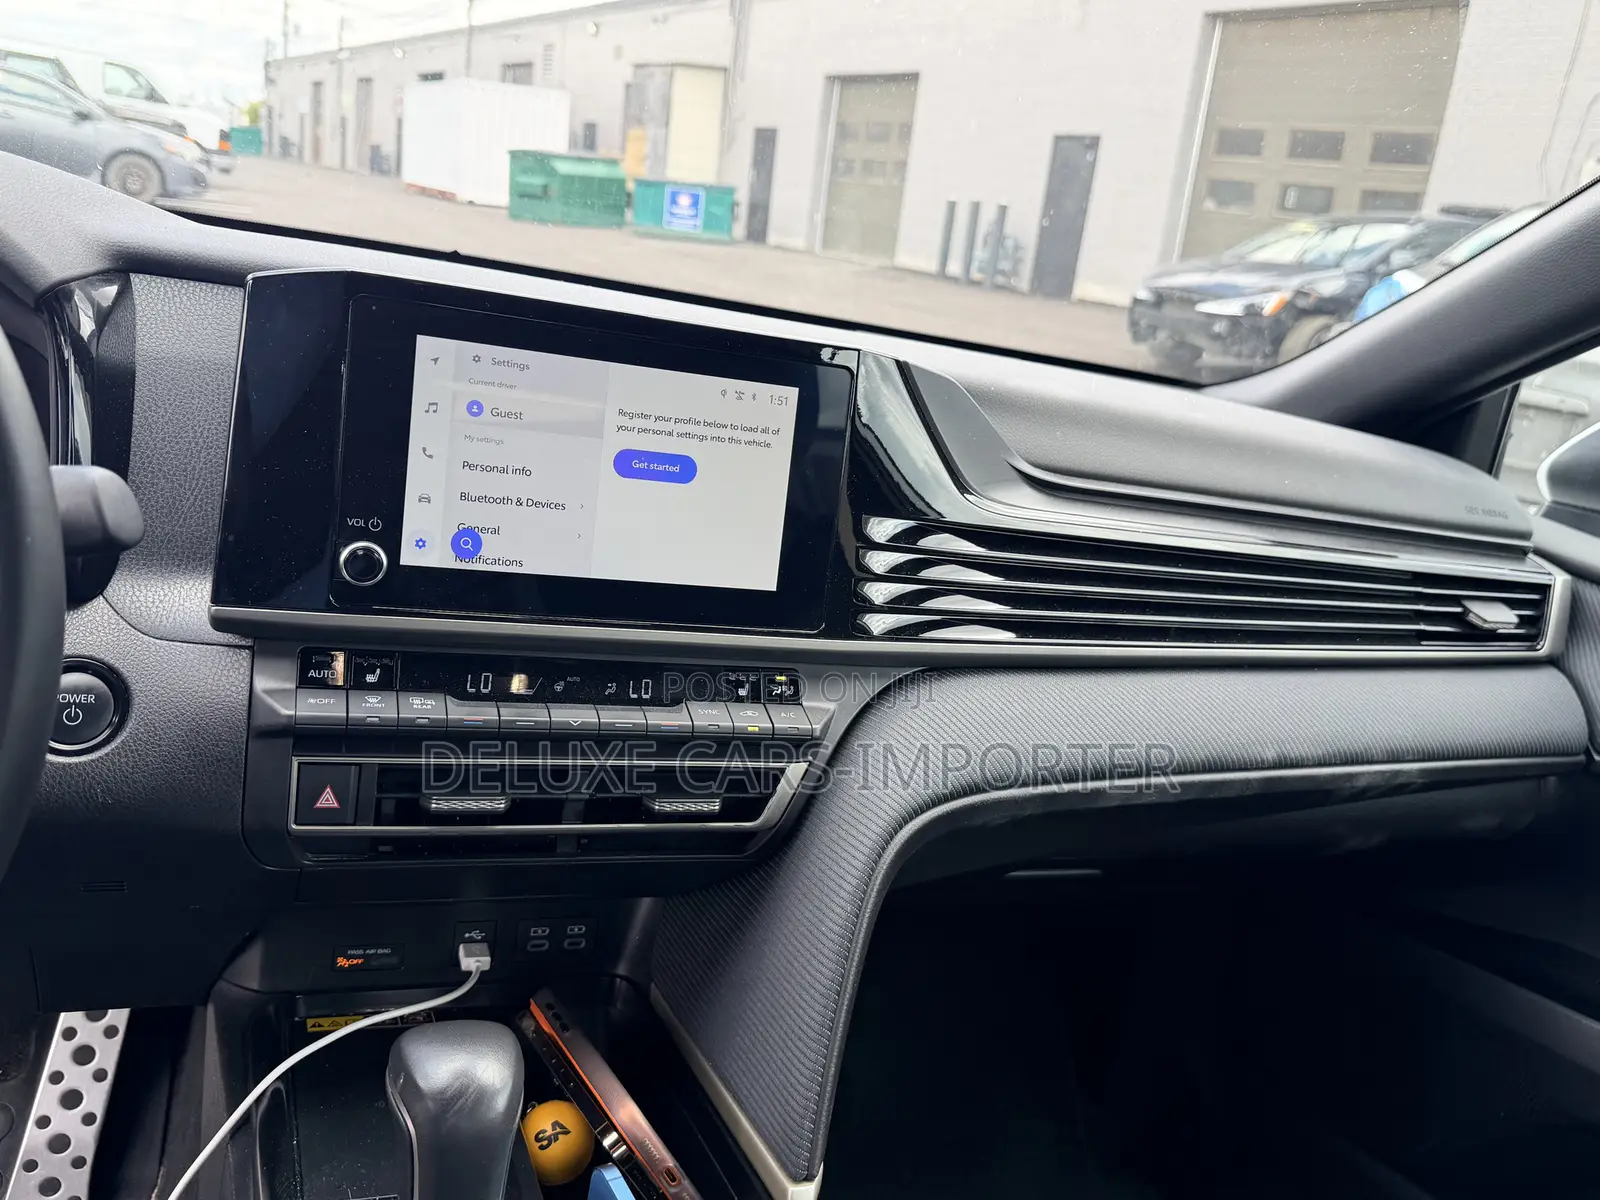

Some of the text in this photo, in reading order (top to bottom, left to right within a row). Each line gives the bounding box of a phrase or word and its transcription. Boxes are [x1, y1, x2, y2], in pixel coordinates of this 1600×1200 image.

[491, 357, 531, 371] Settings
[468, 377, 517, 390] Current driver
[769, 394, 789, 406] 1:51
[490, 407, 524, 421] Guest
[618, 408, 781, 436] Register your profile below to load all of
[463, 434, 504, 446] My settings
[616, 424, 773, 449] your personal settings into this vehicle.
[462, 460, 533, 477] Personal info
[632, 460, 680, 473] Get started
[459, 491, 567, 511] Bluetooth & Devices
[346, 518, 366, 527] VOL
[308, 669, 337, 678] AUTO
[467, 672, 493, 693] LO
[629, 679, 652, 698] LO
[698, 708, 721, 716] SYNC
